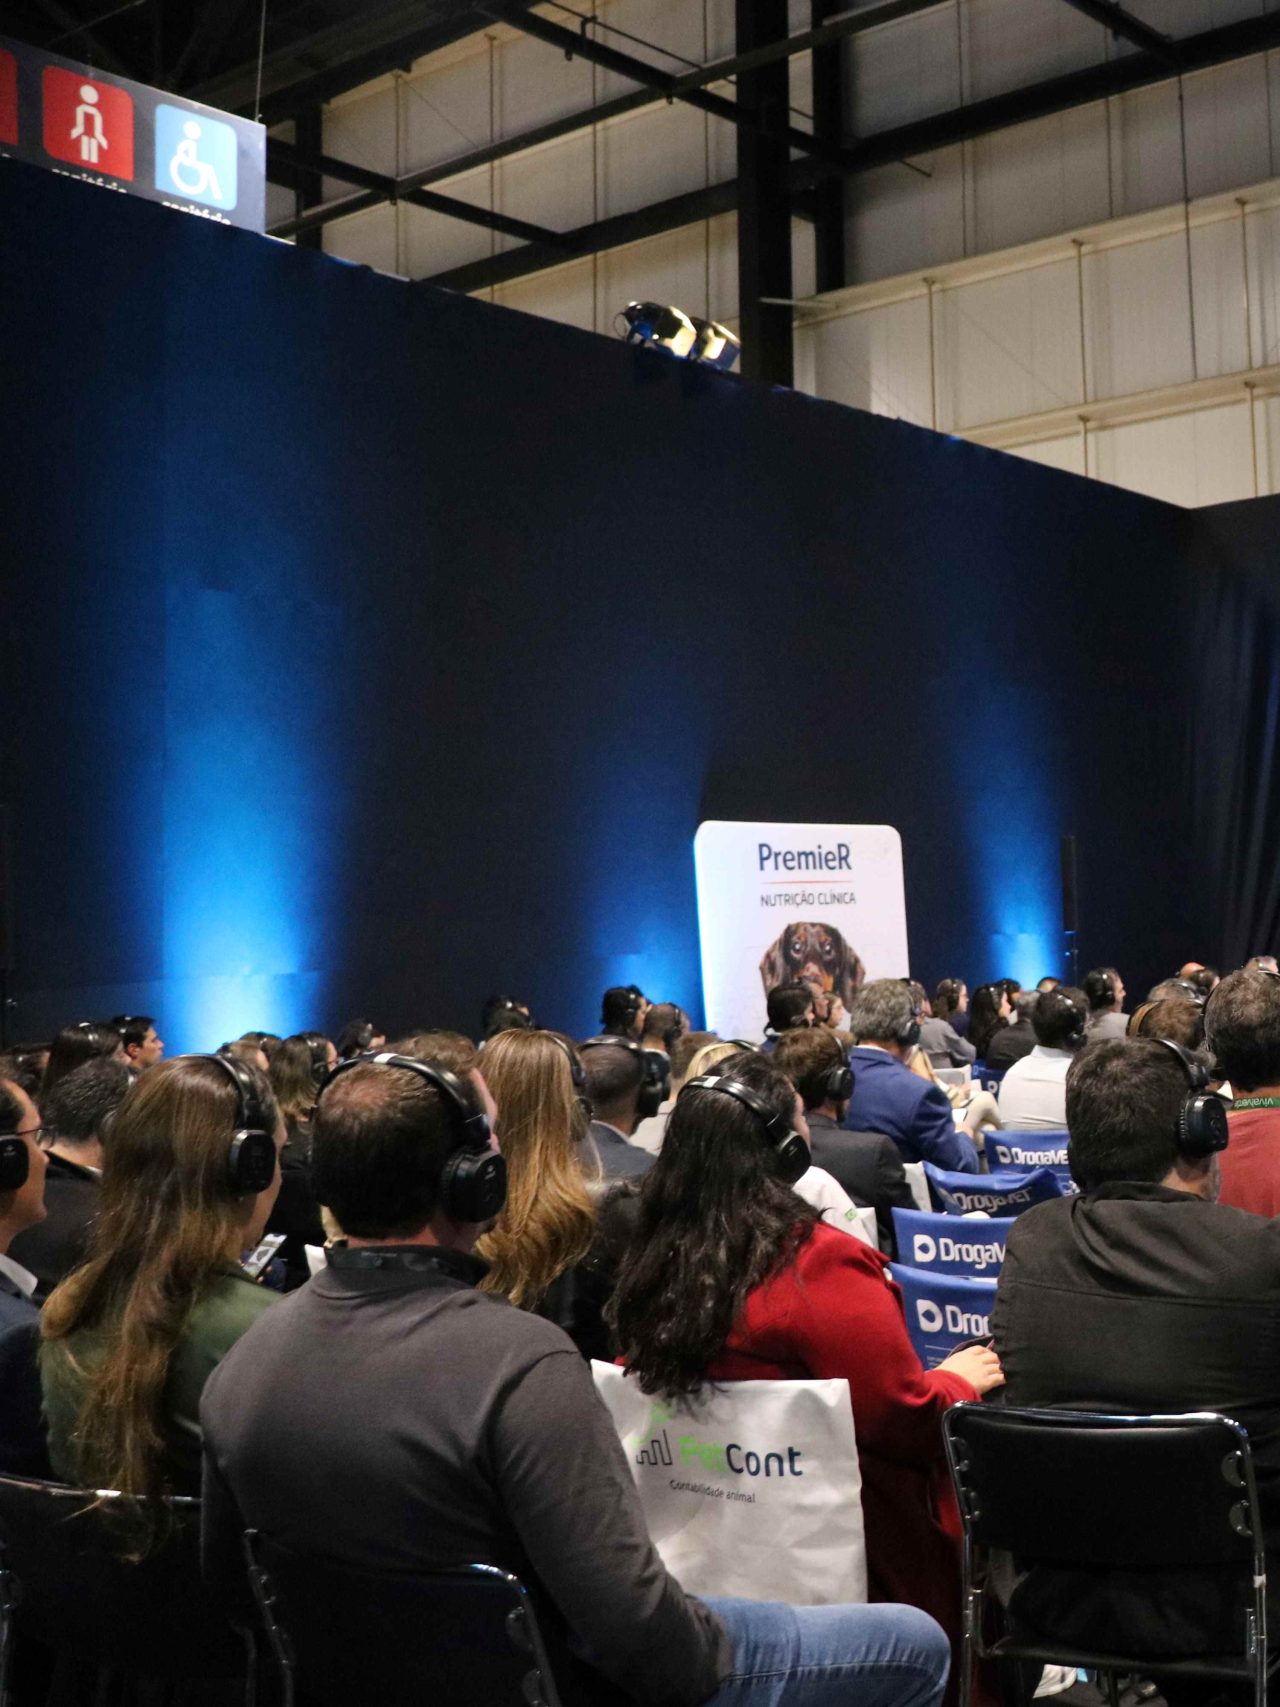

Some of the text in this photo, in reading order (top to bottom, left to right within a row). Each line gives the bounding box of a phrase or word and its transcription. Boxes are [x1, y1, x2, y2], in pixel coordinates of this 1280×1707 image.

[758, 843, 852, 871] PremieR
[760, 889, 856, 907] NUTRIÇÃO CLÍNICA
[1011, 1147, 1069, 1165] DrogaVE
[939, 1238, 1006, 1270] DrogaV
[726, 1490, 756, 1504] animal
